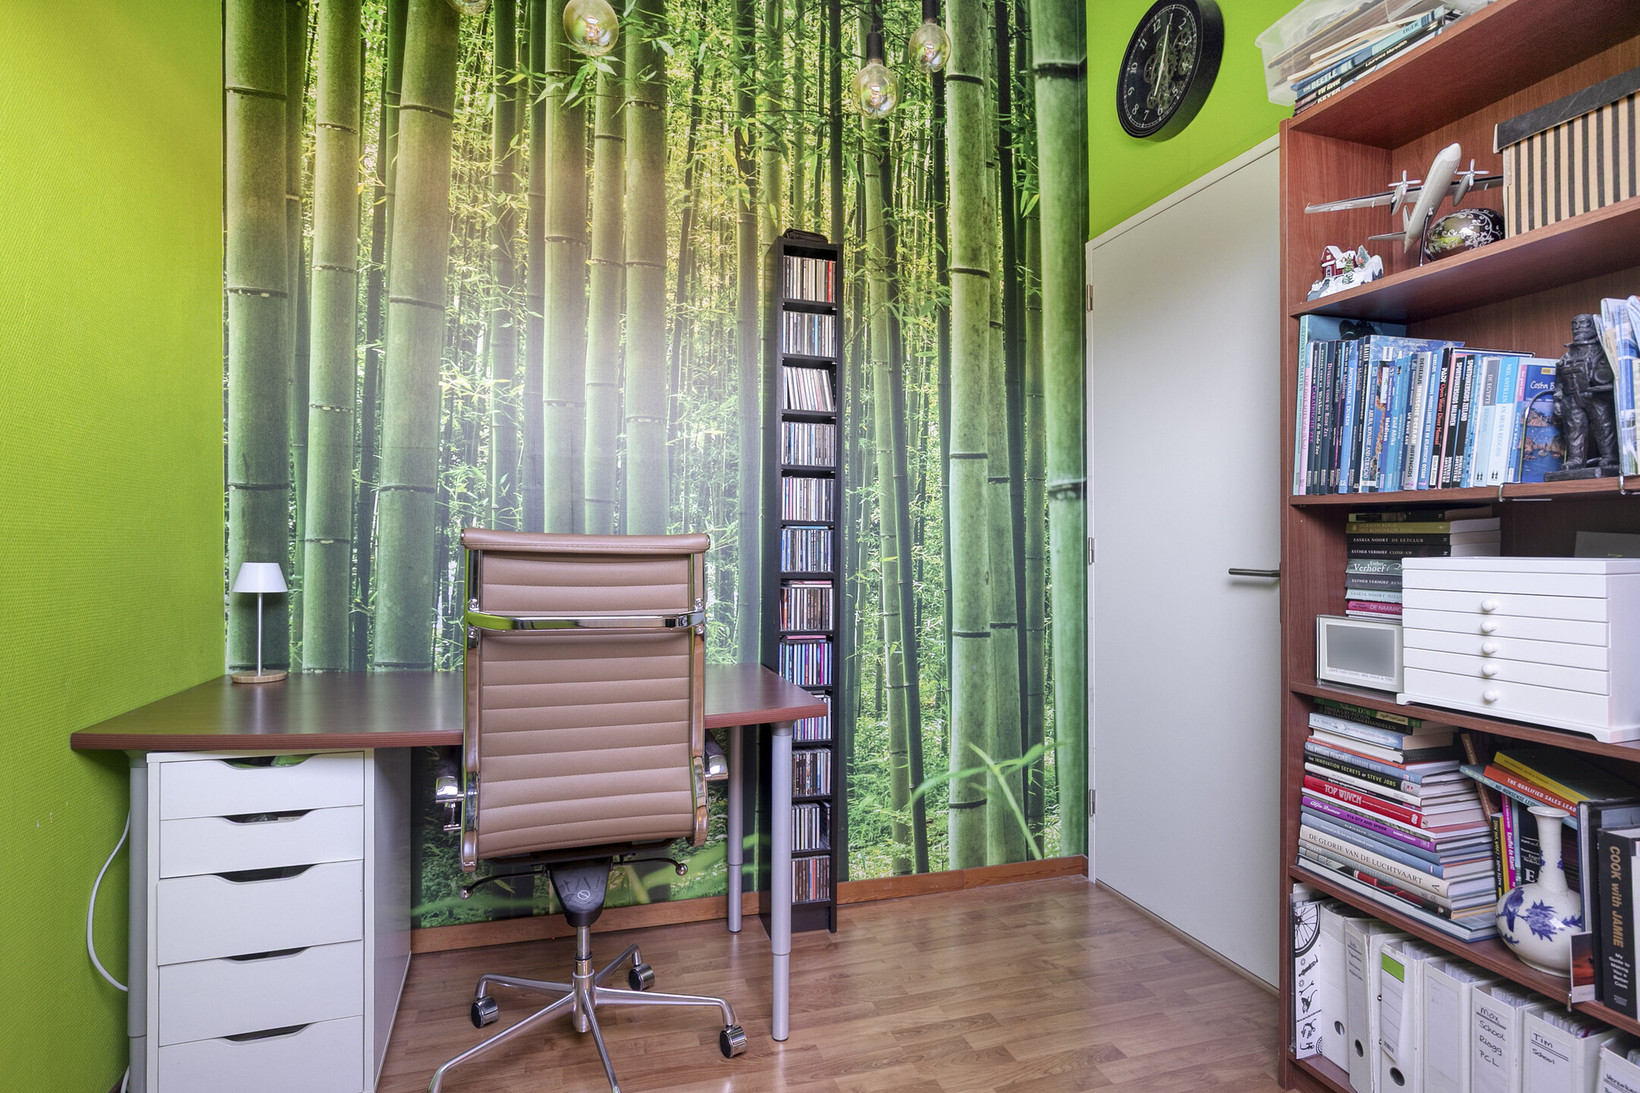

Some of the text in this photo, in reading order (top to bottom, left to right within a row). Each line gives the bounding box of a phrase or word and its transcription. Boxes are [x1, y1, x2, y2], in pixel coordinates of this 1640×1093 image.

[1169, 13, 1174, 25] 1
[1178, 18, 1186, 30] 2
[1152, 18, 1162, 33] 12
[1140, 39, 1148, 50] 11
[1184, 36, 1192, 46] 3
[1130, 62, 1138, 74] 10
[1182, 62, 1190, 72] 4
[1311, 68, 1338, 90] BEETLE
[1171, 88, 1178, 97] 5
[1317, 86, 1342, 104] KEVER
[1132, 104, 1140, 115] 8
[1143, 110, 1149, 121] 7
[1158, 106, 1164, 116] 6
[1463, 360, 1474, 402] SPORTDUIKERSGIDS
[1530, 380, 1548, 390] Costa
[1450, 362, 1462, 426] SPORTDUIKERSGIDS MALDIVEN
[1414, 386, 1422, 416] INDISCHE
[1461, 403, 1469, 422] ZEELAND
[1411, 417, 1420, 444] OCEAAN
[1354, 563, 1387, 572] Verhoef
[1315, 757, 1340, 769] INNOVATION
[1341, 765, 1361, 776] SECRETS
[1367, 774, 1382, 783] STEVE
[1384, 779, 1396, 787] JOBS
[1325, 784, 1339, 796] TOP
[1495, 784, 1526, 801] NO-NONSENSE
[1507, 778, 1516, 786] THE
[1518, 782, 1544, 798] QUALIFIED
[1544, 794, 1561, 806] SALES
[1310, 800, 1341, 816] Alfa Romeo
[1374, 822, 1387, 832] SPIDER
[1309, 833, 1422, 884] DE GLORIE VAN DE LUCHTVAART
[1609, 846, 1624, 948] COOK with JAMIE
[1608, 956, 1624, 967] Guide
[1610, 962, 1628, 973] Making
[1612, 968, 1622, 976] You
[1614, 974, 1628, 984] Better
[1614, 980, 1628, 990] Cook
[1480, 1007, 1500, 1022] Max
[1480, 1020, 1506, 1041] School
[1533, 1032, 1553, 1048] Tim
[1532, 1048, 1556, 1064] School
